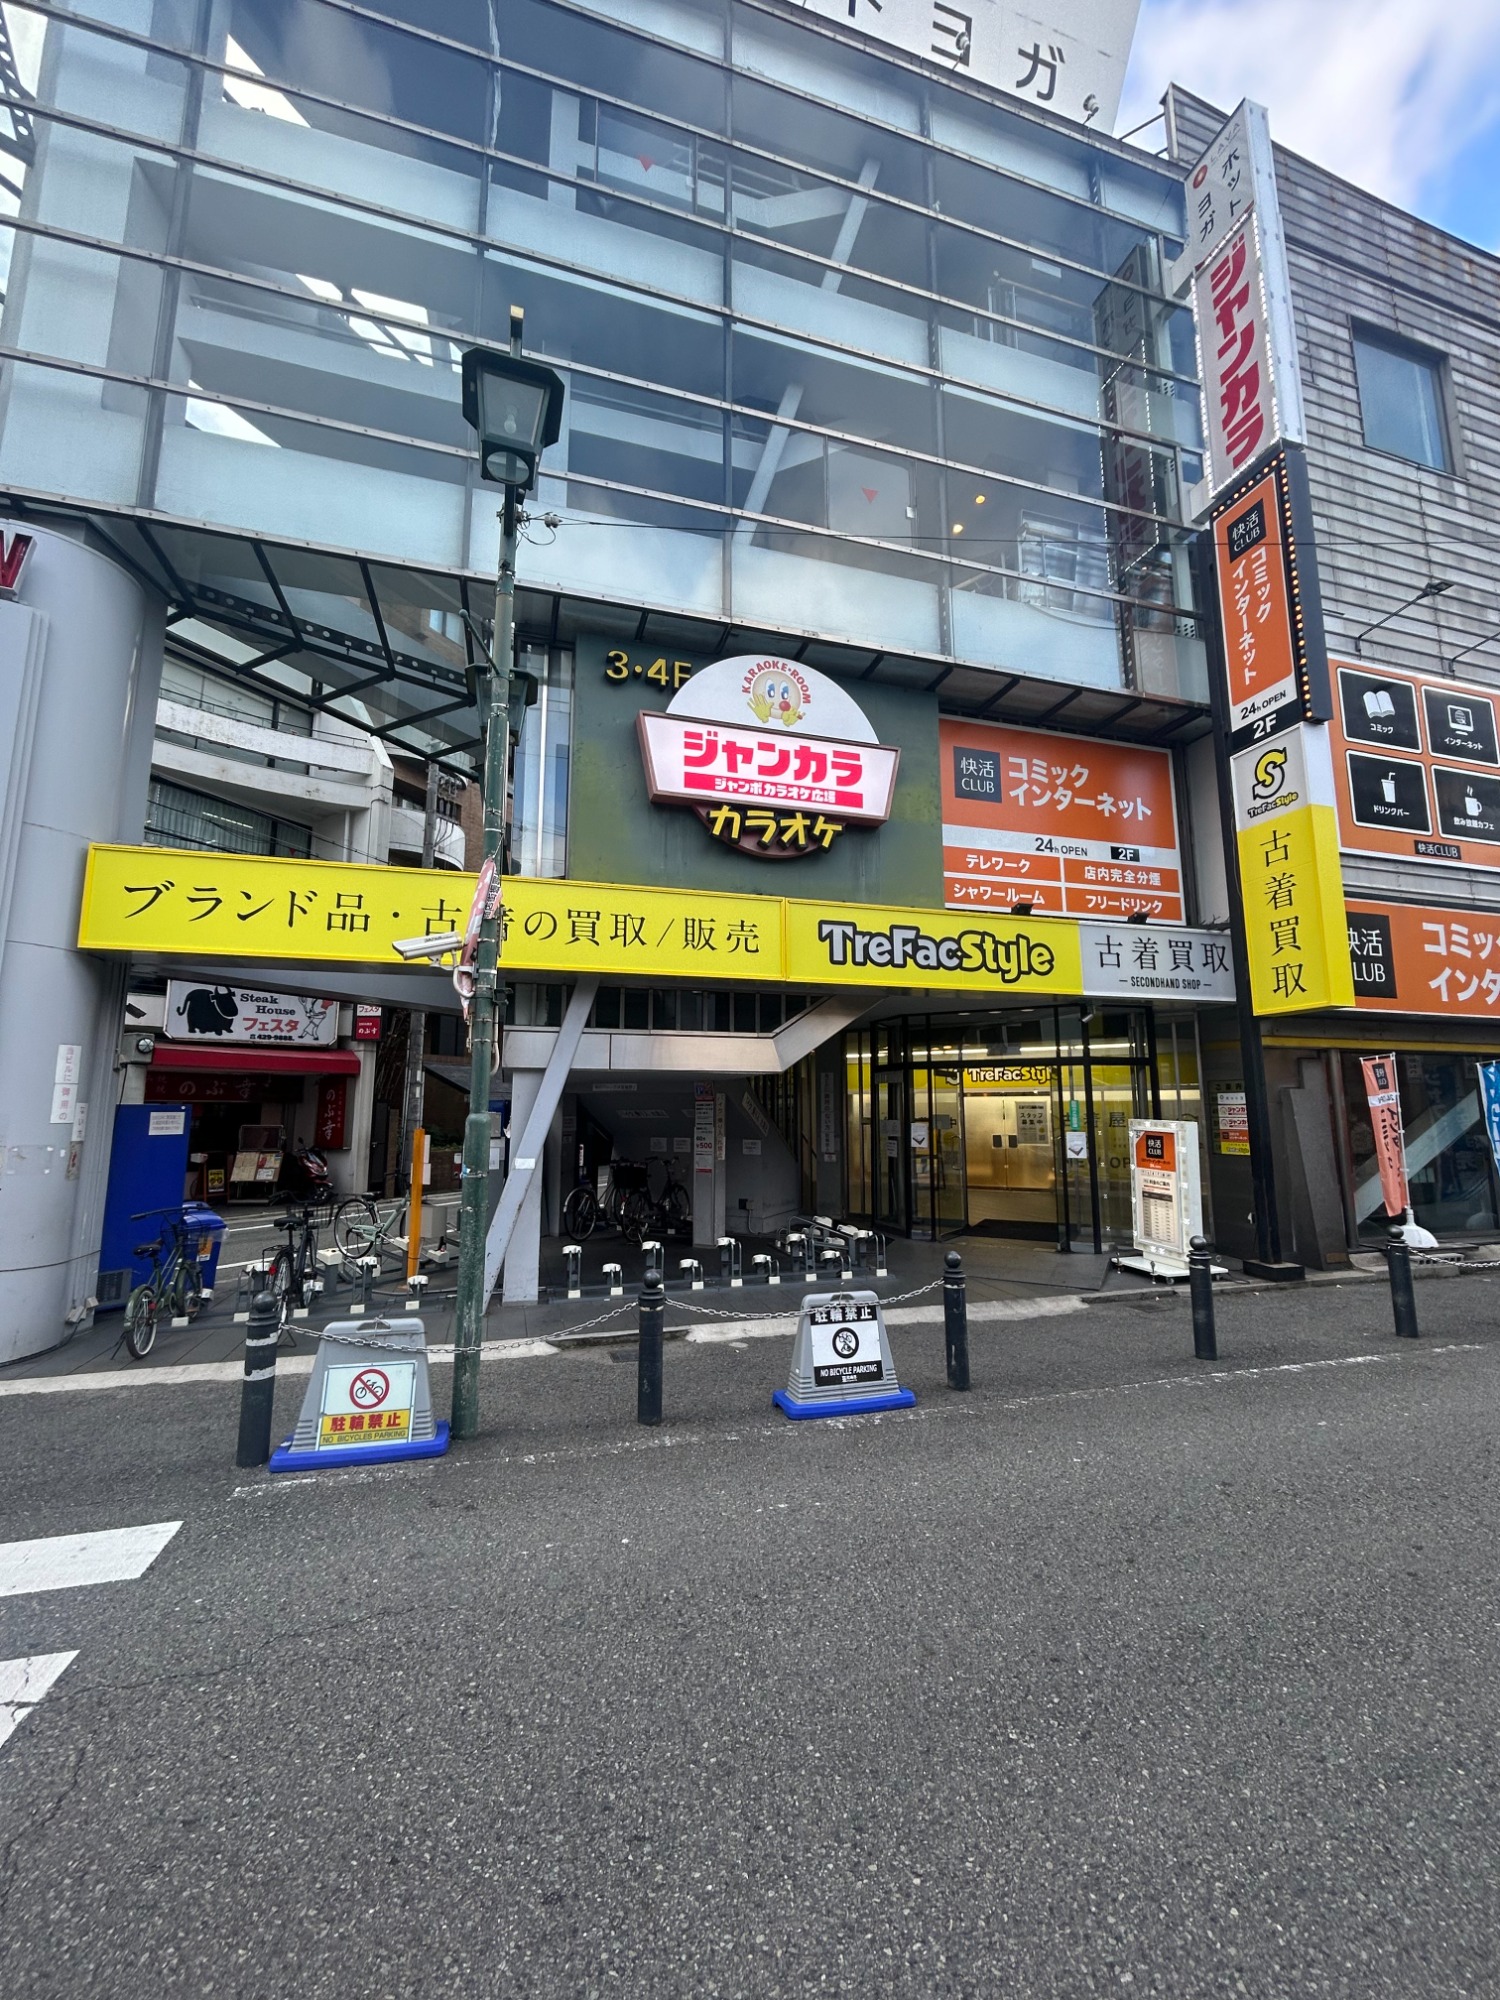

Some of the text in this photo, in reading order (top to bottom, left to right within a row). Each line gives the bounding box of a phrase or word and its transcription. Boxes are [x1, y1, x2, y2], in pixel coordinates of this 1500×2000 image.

[1222, 147, 1242, 217] ホット
[1198, 192, 1216, 243] ヨガ
[1211, 232, 1264, 470] ジャンカラ
[1231, 510, 1260, 541] 快活
[1233, 527, 1261, 553] CLUB
[1251, 546, 1273, 624] コミック
[1232, 559, 1258, 687] インターネット
[1261, 690, 1287, 711] OPEN
[1253, 713, 1277, 740] 2F
[1369, 723, 1394, 734] コミック
[1444, 737, 1483, 751] インターネット
[684, 730, 863, 787] ジャンカラ
[960, 756, 995, 778] 快活
[1008, 756, 1089, 788] コミック
[714, 777, 837, 804] ジャンボカラオケ広場
[961, 778, 995, 794] CLUB
[1009, 782, 1152, 821] インターネット
[1247, 791, 1299, 819] TreFacStyle
[1373, 804, 1410, 817] ドリンクバー
[708, 804, 845, 849] カラオケ
[1061, 845, 1088, 857] OPEN
[1118, 848, 1134, 861] 2F
[966, 854, 1031, 873] テレワーク
[1084, 865, 1161, 886] 店内完全分煙
[953, 883, 1045, 905] シャワールーム
[1085, 895, 1162, 914] フリードリンク
[1260, 829, 1308, 999] 古着買取
[818, 919, 1054, 984] TreFacStyle
[1422, 922, 1500, 960] コミッ
[1094, 934, 1230, 974] 古着買取
[1353, 961, 1386, 982] LUB
[1131, 976, 1201, 990] SECONDHAND SHOP
[240, 993, 279, 1005] Steak
[255, 1005, 296, 1016] House
[243, 1017, 300, 1033] フェスタ
[820, 1364, 878, 1377] NO BICYCLE PARKING
[330, 1412, 401, 1433] 駐輪禁止
[322, 1429, 406, 1444] NO BICYCLES PARKING
